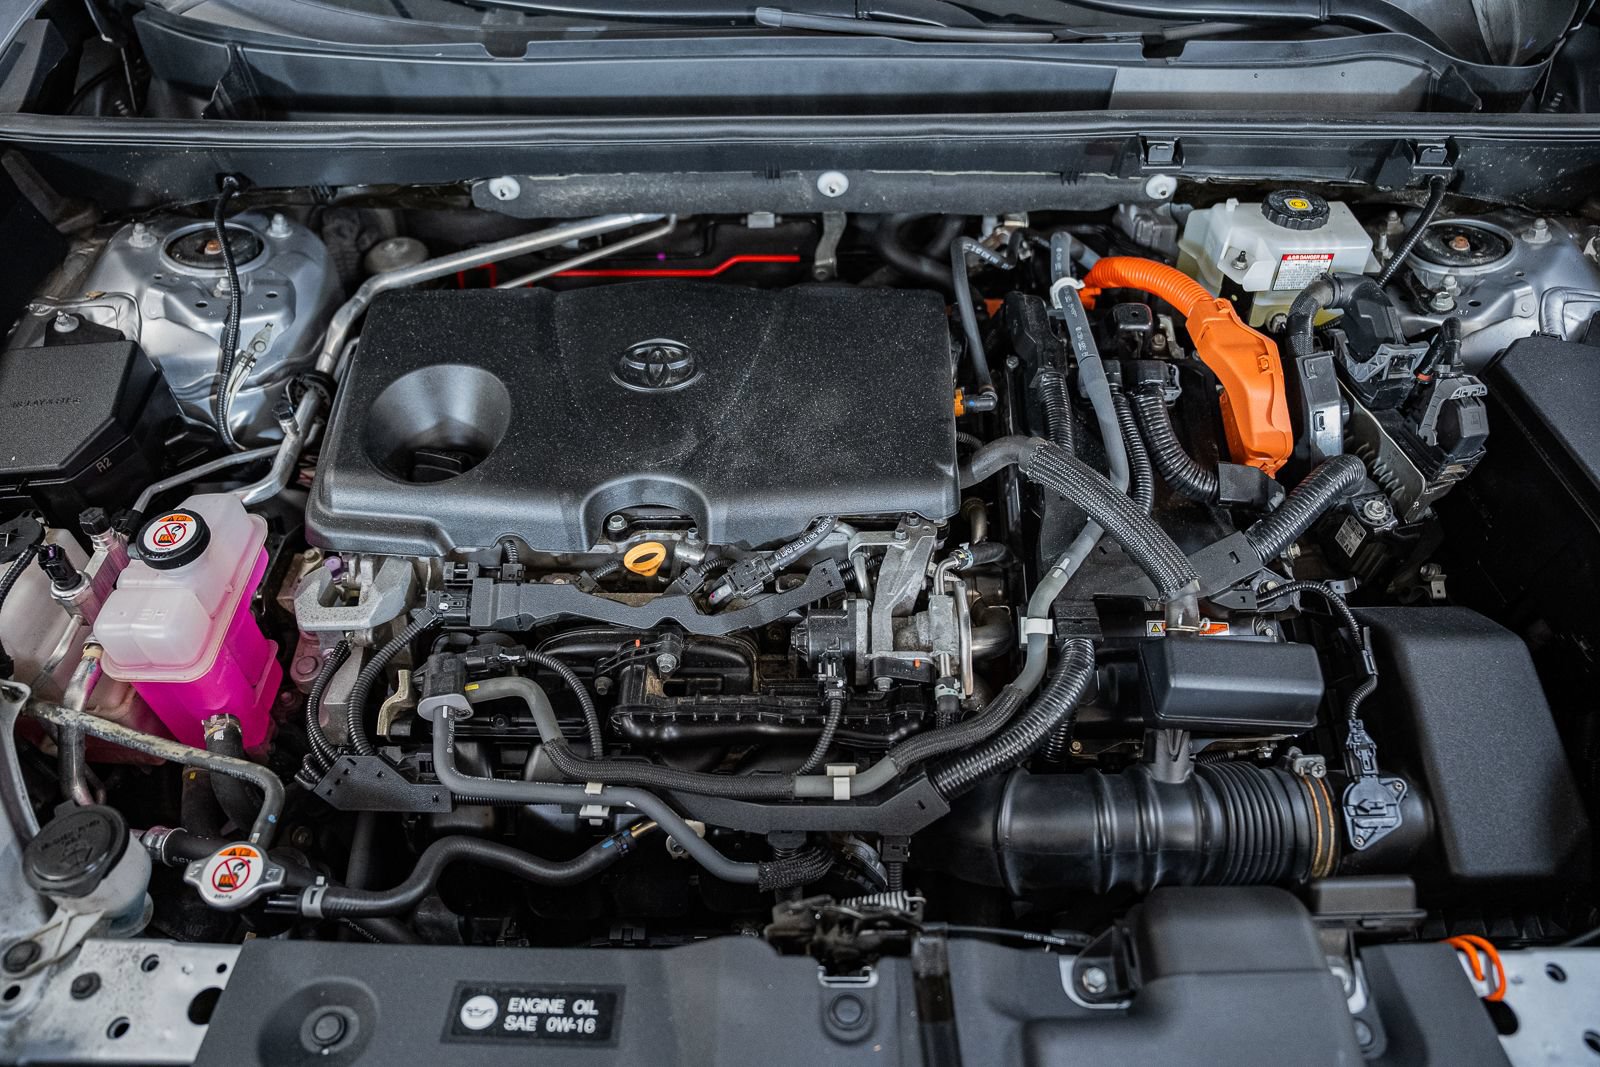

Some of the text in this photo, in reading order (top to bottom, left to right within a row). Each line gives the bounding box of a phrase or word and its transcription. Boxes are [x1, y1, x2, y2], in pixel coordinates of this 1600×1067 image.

[96, 457, 112, 472] R2
[507, 996, 599, 1015] ENGINE OIL
[504, 1015, 597, 1034] SAE 0W-16
